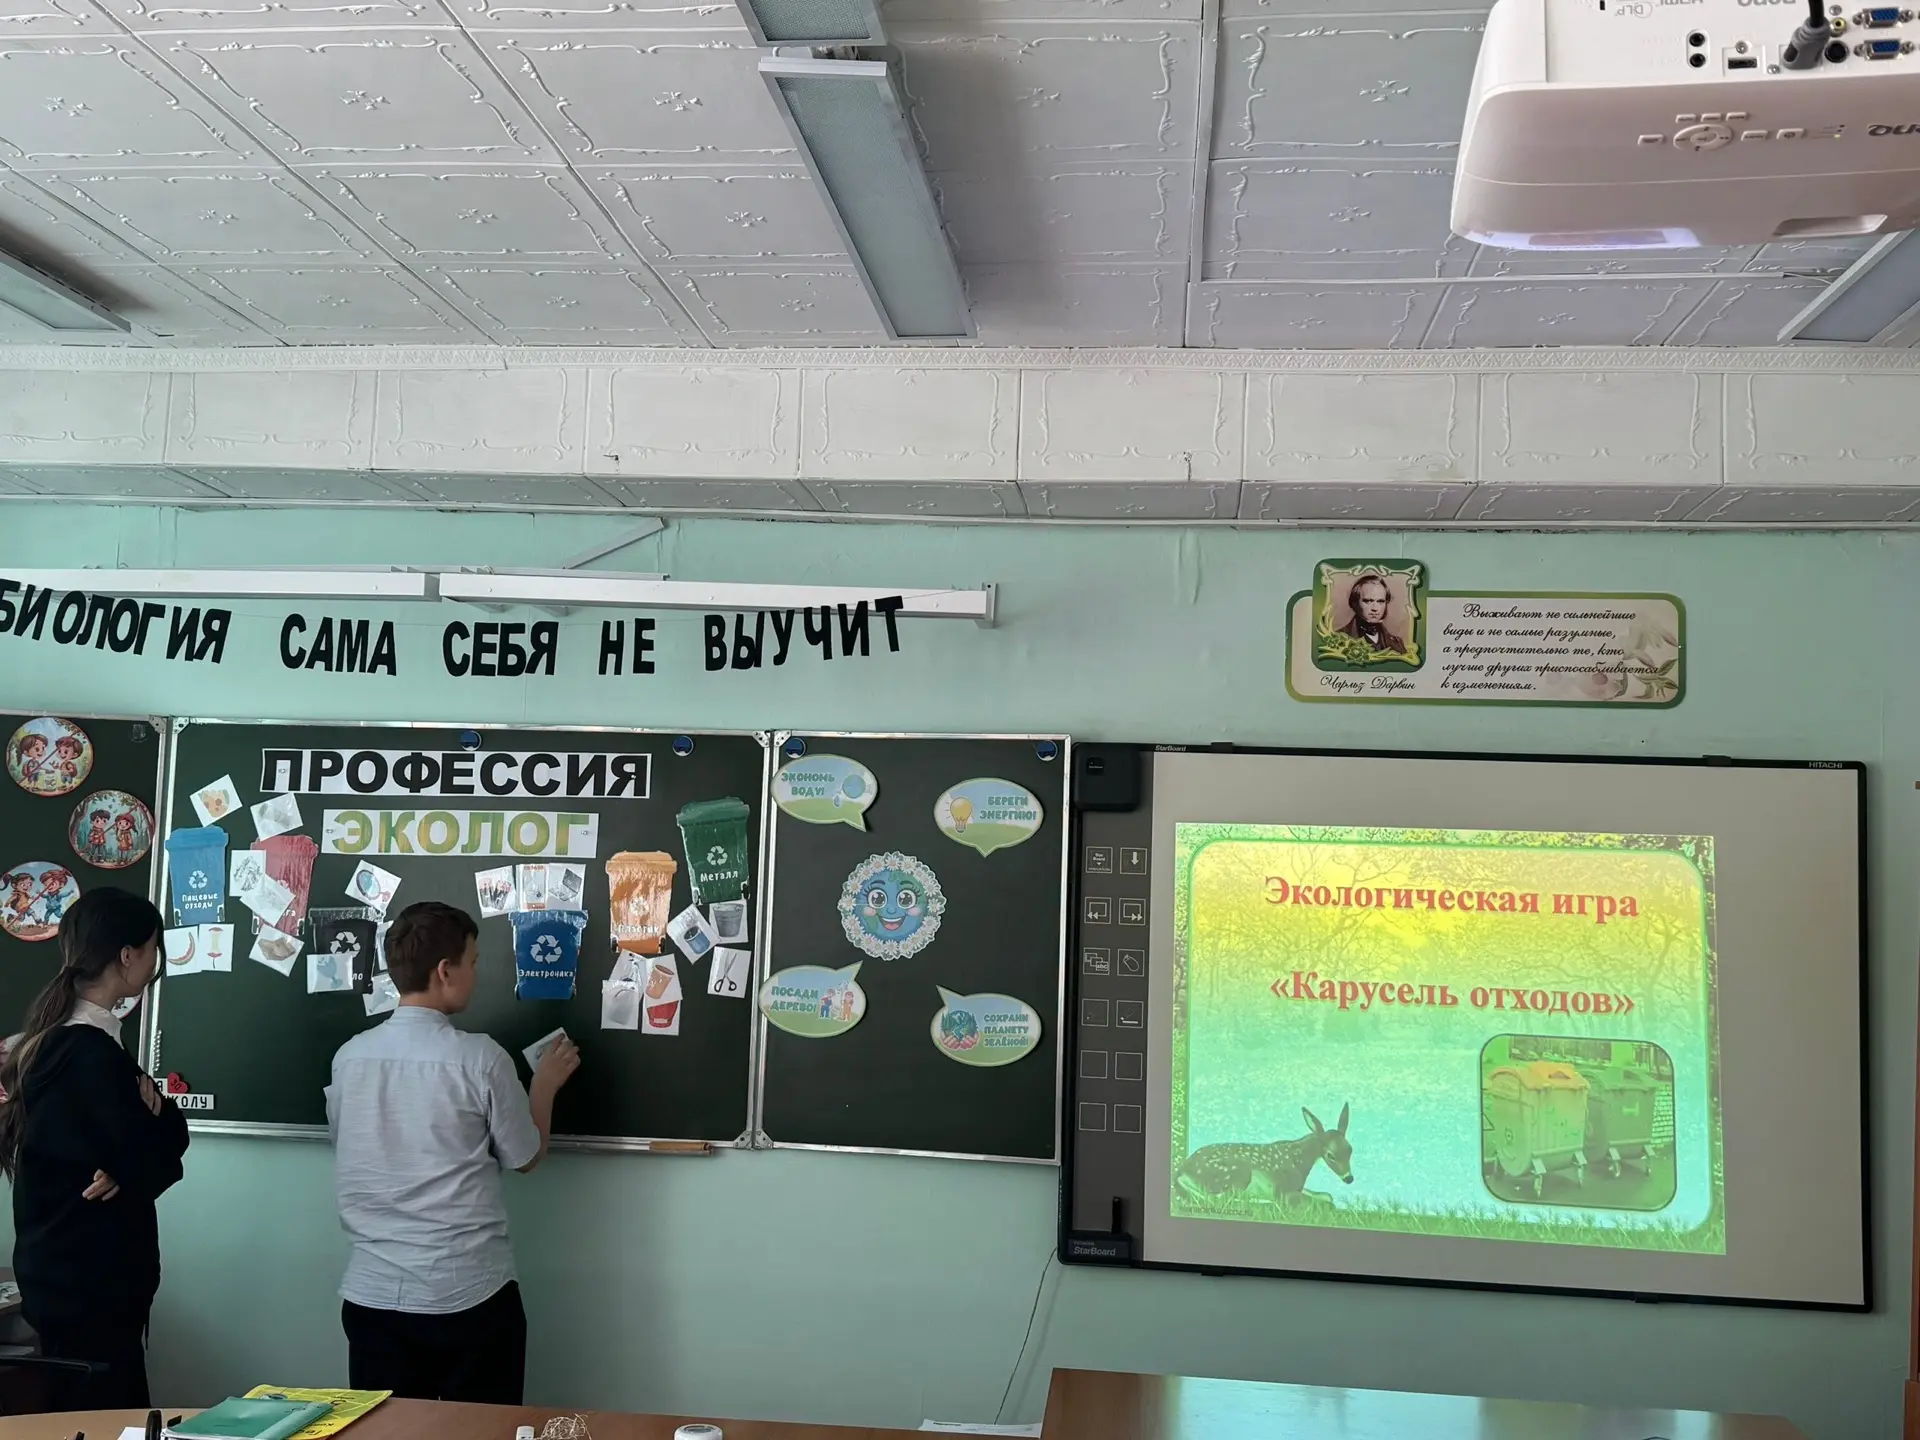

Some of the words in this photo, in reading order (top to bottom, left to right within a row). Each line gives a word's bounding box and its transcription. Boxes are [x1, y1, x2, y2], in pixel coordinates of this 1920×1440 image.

[1463, 603, 1542, 619] Выживают
[1563, 610, 1636, 620] сильнейшие
[0, 578, 231, 664] БИОЛОГИЯ
[280, 613, 397, 676] САМА
[442, 620, 559, 677] СЕБЯ
[598, 617, 656, 676] НЕ
[704, 595, 904, 671] ВЫУЧИТ
[1443, 623, 1474, 641] виды
[1543, 627, 1616, 642] разумные,
[1443, 646, 1451, 654] а
[1454, 643, 1569, 659] предпочтительно
[1573, 647, 1595, 657] те,
[1597, 643, 1625, 656] кто
[1442, 664, 1484, 677] лучше
[1485, 662, 1532, 677] других
[1535, 661, 1659, 677] приспосабливается
[1320, 675, 1366, 693] Чарльз
[1370, 676, 1416, 693] Дарвин
[1441, 676, 1450, 689] к
[1453, 682, 1536, 693] изменениям.
[262, 749, 647, 796] ПРОФЕССИЯ
[1808, 761, 1843, 769] HITACHI
[781, 772, 835, 782] ЭКОНОМЬ
[791, 786, 824, 797] ВОДУ!
[987, 796, 1028, 806] БЕРЕГИ
[980, 810, 1037, 820] ЭНЕРГИЮ!
[332, 810, 590, 856] ЭКОЛОГ
[700, 870, 738, 882] Металл
[1265, 876, 1540, 914] Экологическая
[1552, 892, 1639, 924] игра
[771, 986, 819, 999] ПОСАДИ
[1271, 970, 1458, 1011] «Карусель
[1470, 985, 1635, 1016] отходов»
[771, 1000, 817, 1012] ДЕРЕВО!
[984, 1014, 1029, 1022] СОХРАНИ
[984, 1026, 1029, 1034] ПЛАНЕТУ
